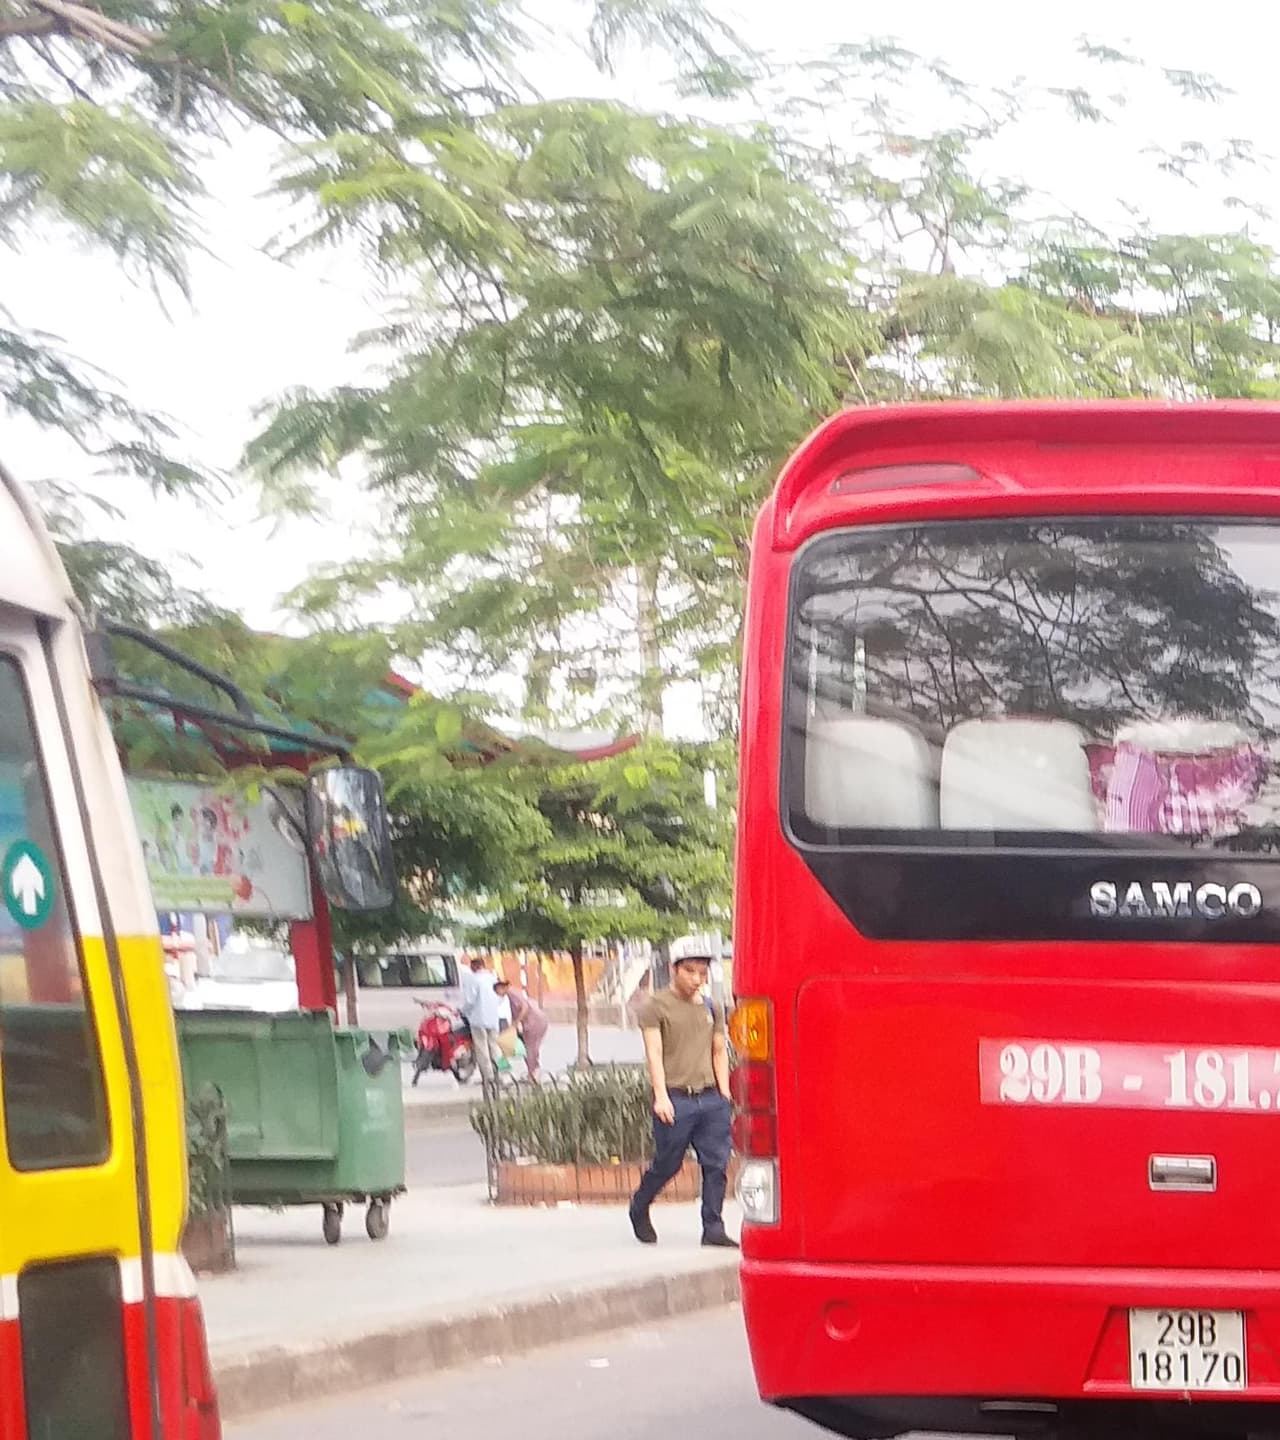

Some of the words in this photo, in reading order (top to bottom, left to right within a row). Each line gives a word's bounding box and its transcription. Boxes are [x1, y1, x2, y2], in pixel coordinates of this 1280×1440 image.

[1089, 881, 1262, 919] SAMCO
[1000, 1044, 1103, 1104] 29B
[1157, 1311, 1216, 1347] 29B
